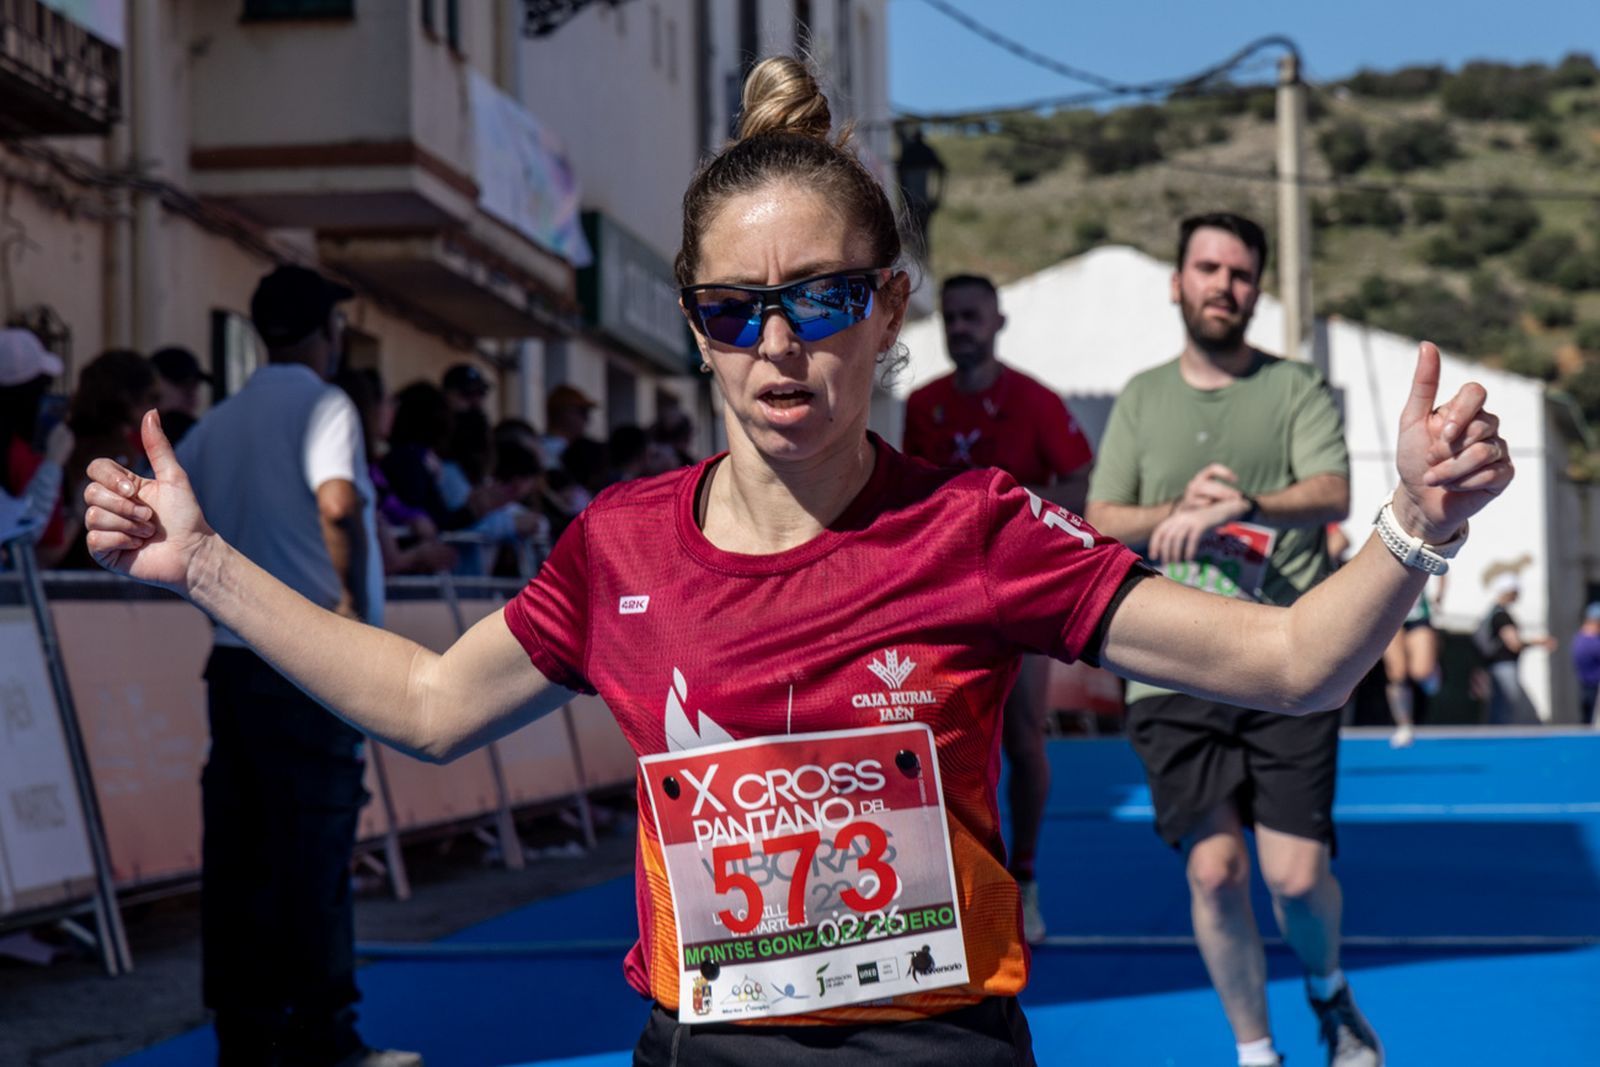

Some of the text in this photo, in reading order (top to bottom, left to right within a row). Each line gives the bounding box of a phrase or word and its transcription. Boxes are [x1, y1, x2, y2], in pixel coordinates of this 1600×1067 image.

[851, 690, 937, 709] CAJA RURAL
[879, 706, 915, 723] JAÉN
[680, 763, 728, 817] X
[732, 759, 886, 811] CROSS
[692, 797, 891, 851] PANTANO DEL
[711, 820, 898, 934] 573
[684, 940, 755, 966] MONTSE
[872, 905, 955, 936] TEJERO
